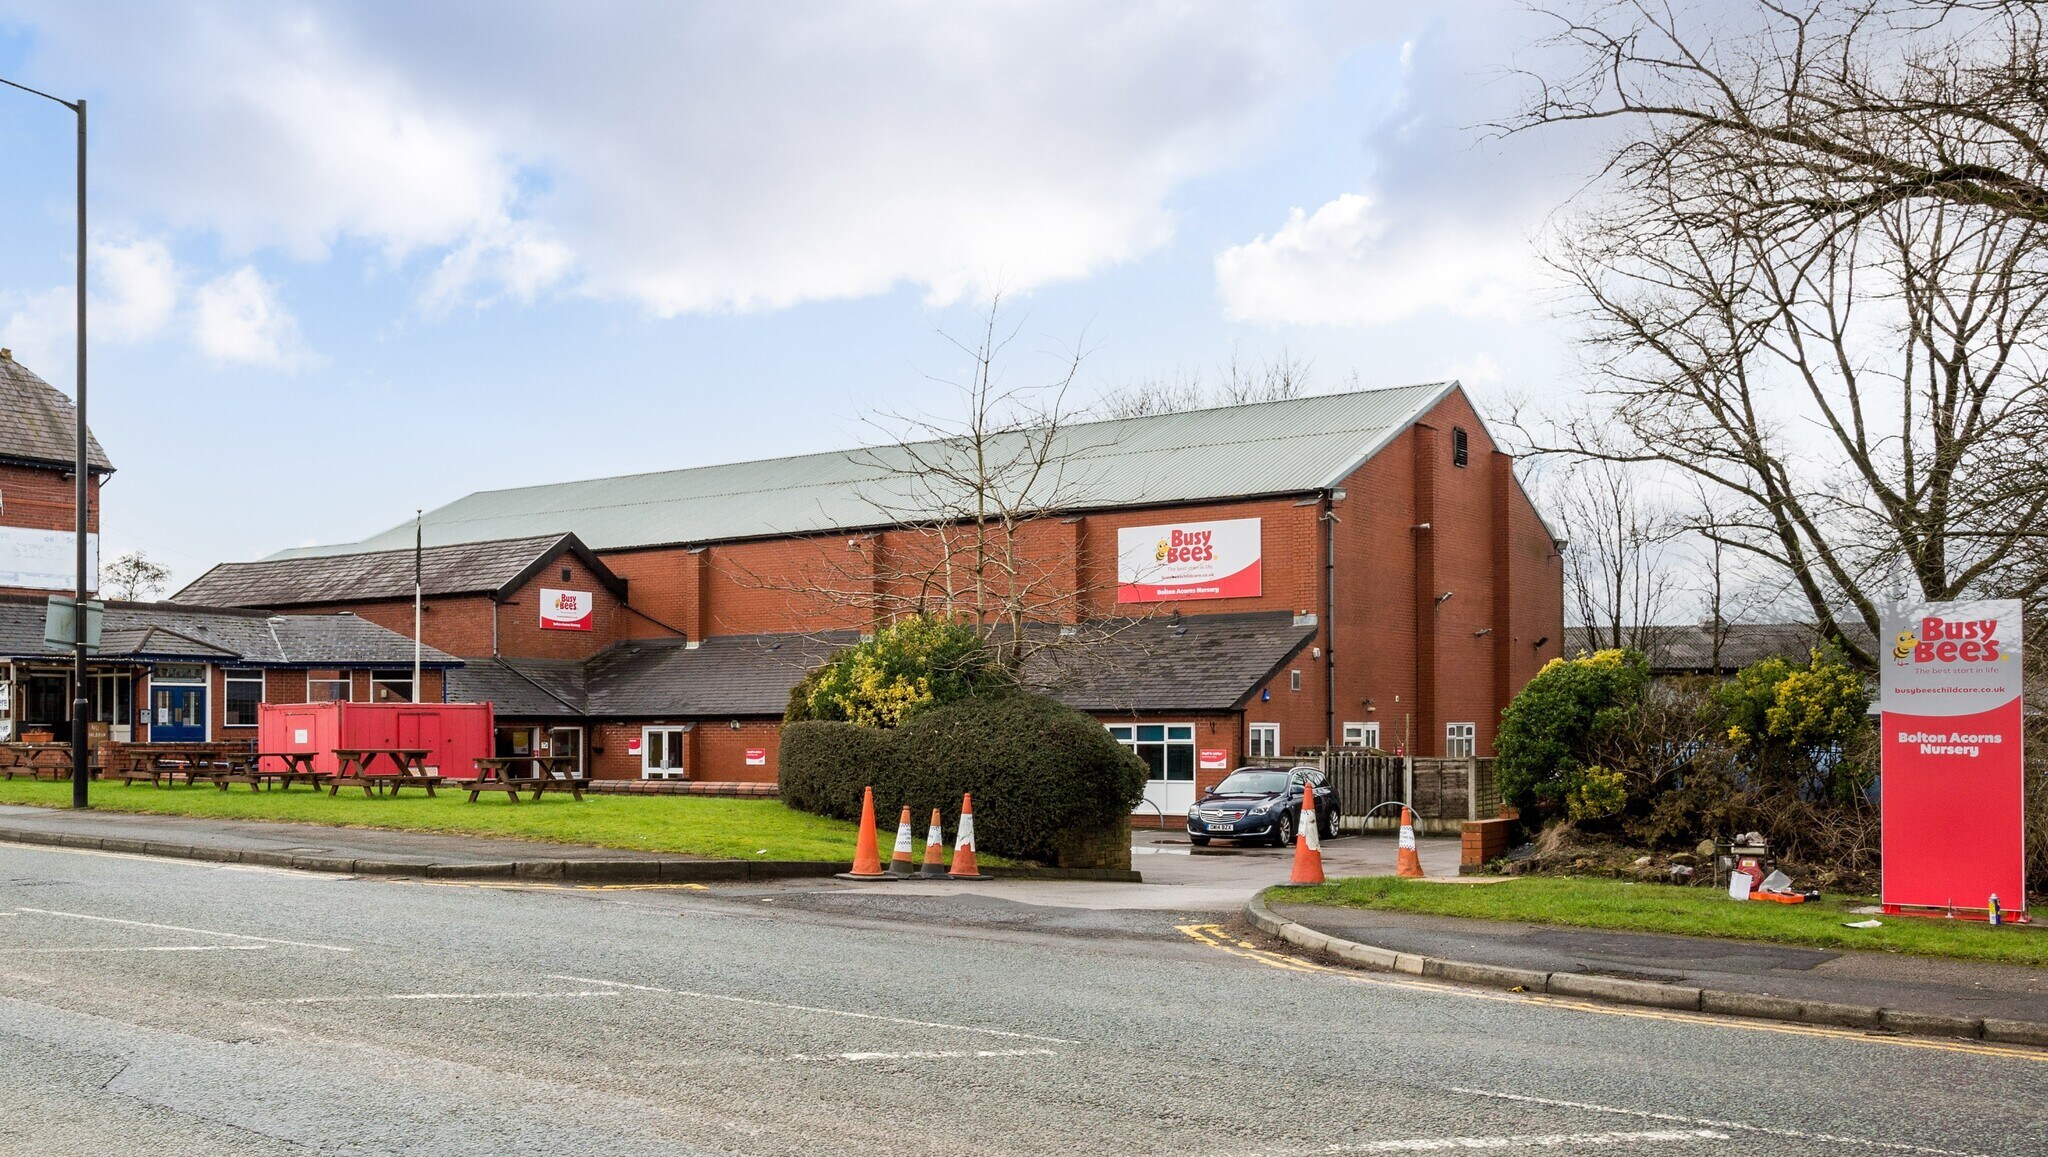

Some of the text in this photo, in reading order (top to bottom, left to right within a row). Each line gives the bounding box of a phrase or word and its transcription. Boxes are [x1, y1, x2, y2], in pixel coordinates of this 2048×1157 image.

[1171, 529, 1212, 547] Busy
[1167, 545, 1213, 563] Bees
[561, 593, 577, 603] Busy
[559, 602, 577, 610] Bees
[1922, 617, 1998, 642] Busy
[1914, 640, 2000, 663] Bees
[1894, 686, 2005, 695] busybeeschildcare.co.uk
[1898, 731, 2002, 744] Bolton Acorns
[1920, 743, 1979, 757] Nursery
